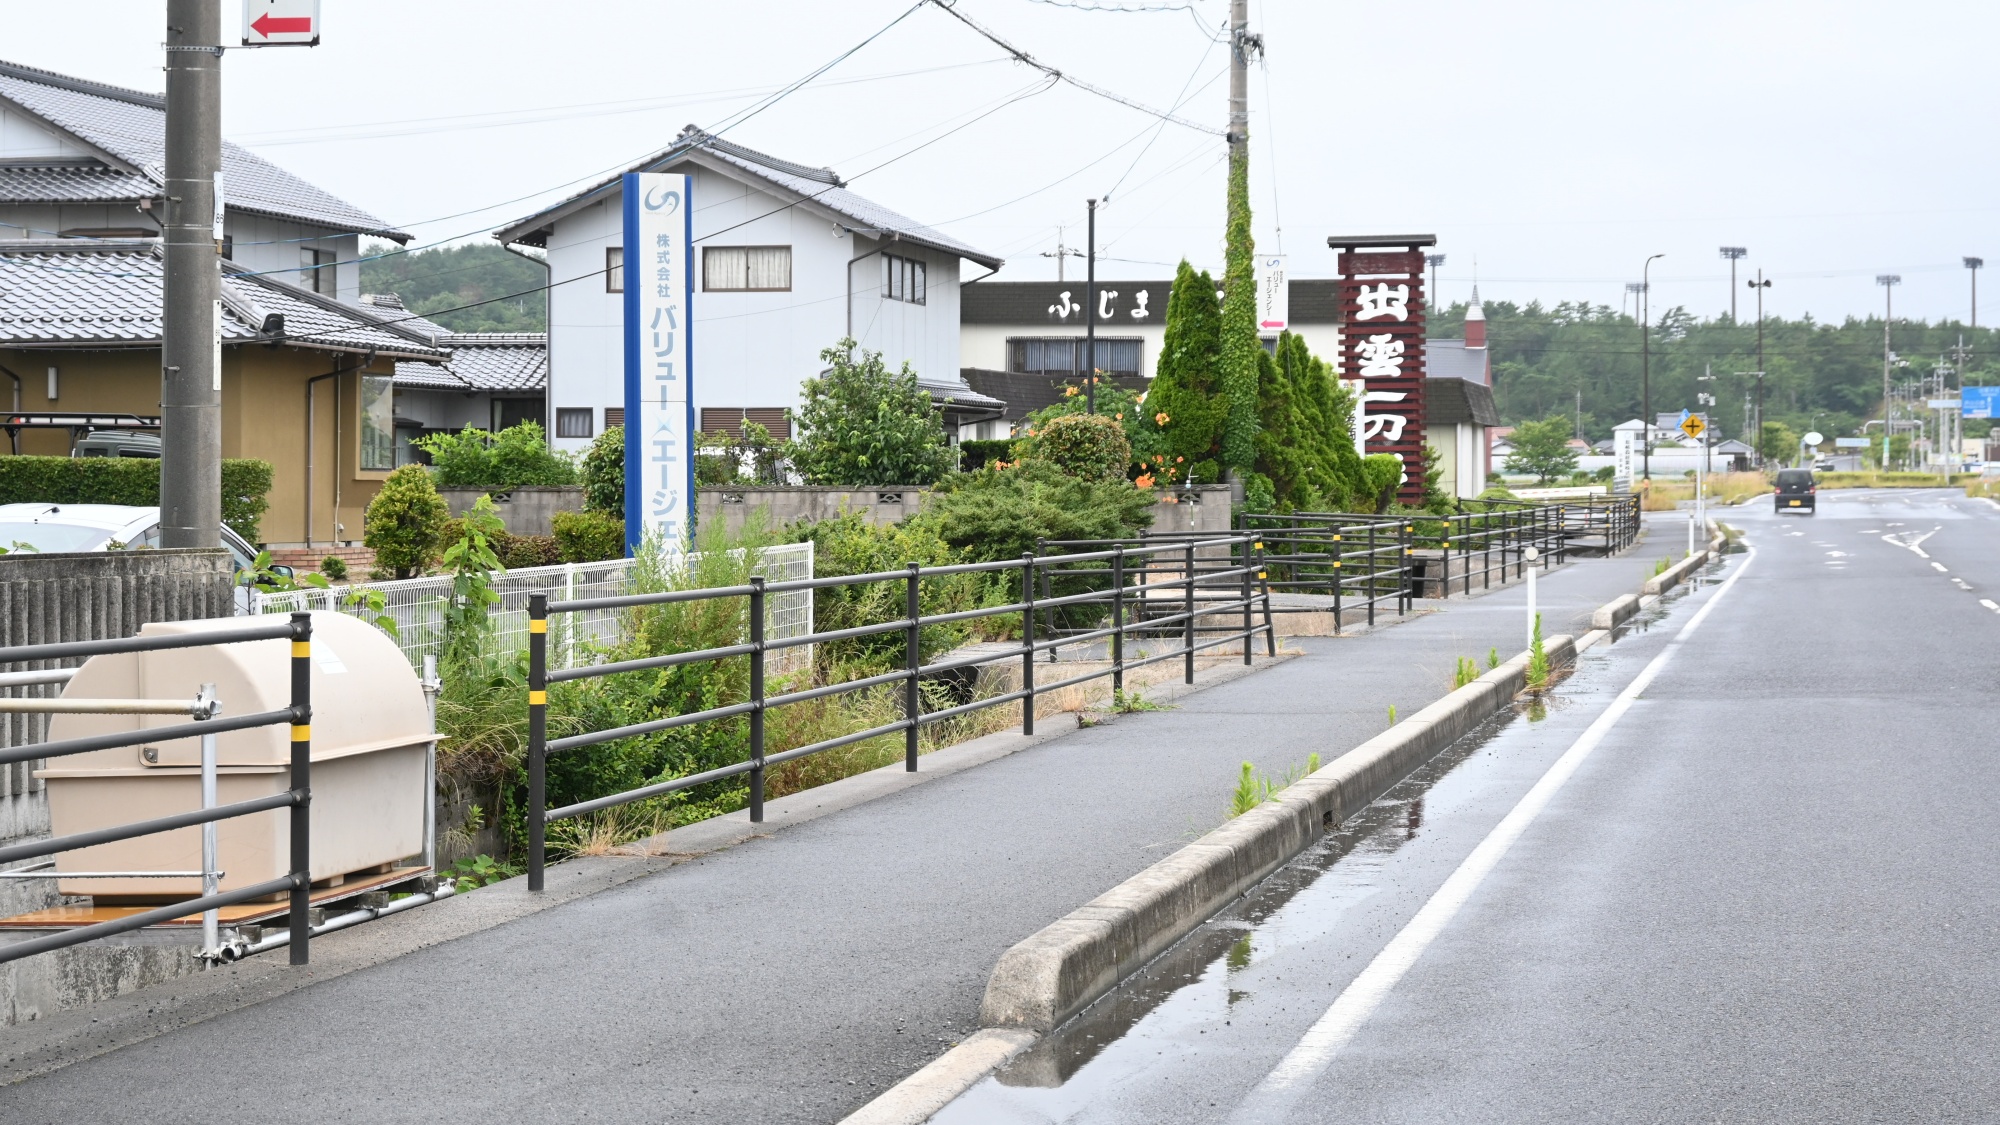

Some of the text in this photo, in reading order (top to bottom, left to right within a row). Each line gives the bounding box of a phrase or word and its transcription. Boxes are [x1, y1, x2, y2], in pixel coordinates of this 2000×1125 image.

[656, 233, 671, 298] 株式会社
[650, 305, 678, 411] バリュー
[1354, 282, 1408, 484] 出雲一刀
[651, 440, 678, 556] エージェ
